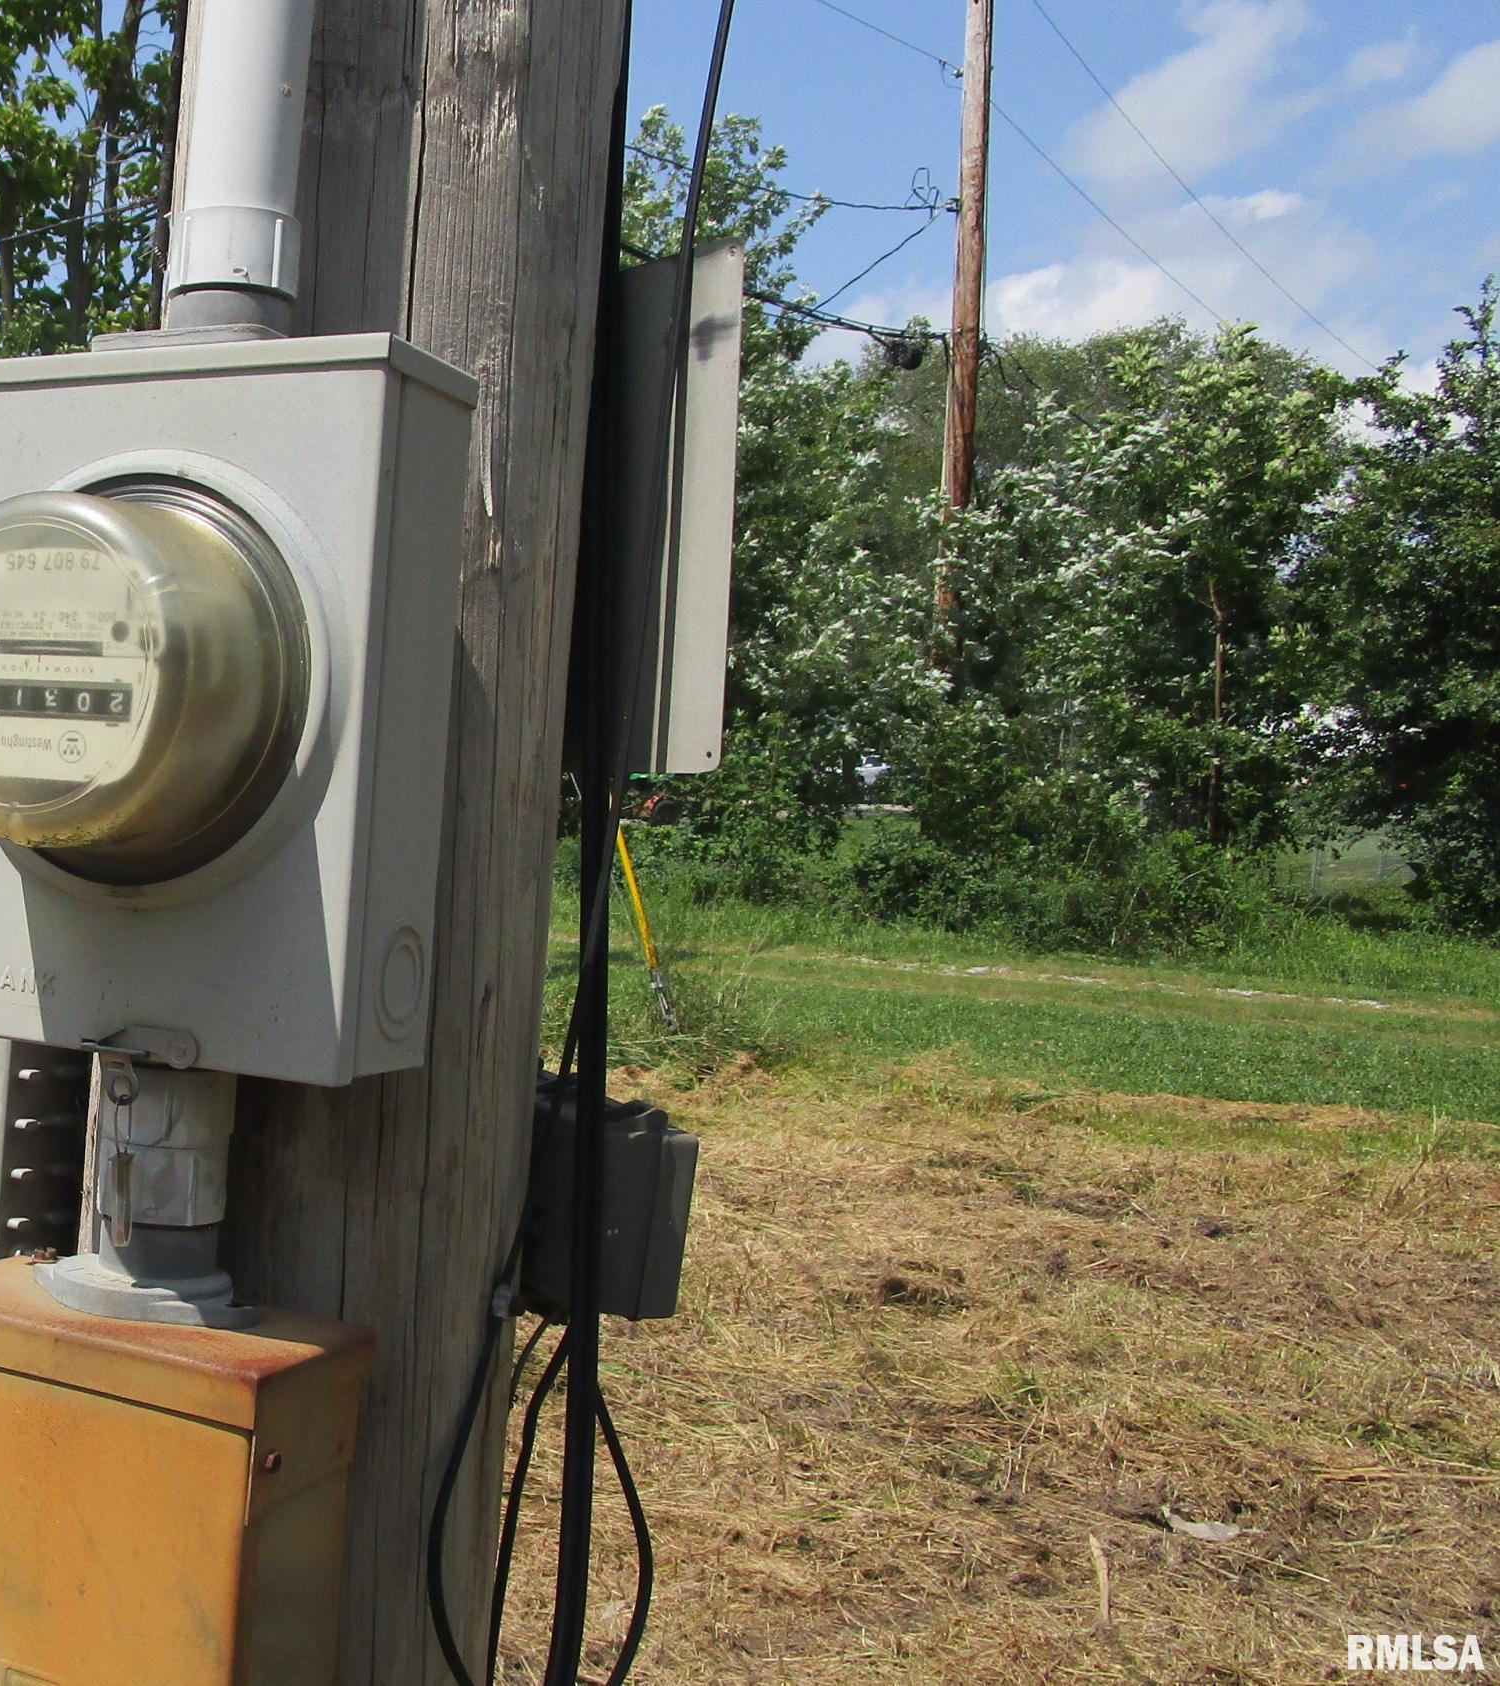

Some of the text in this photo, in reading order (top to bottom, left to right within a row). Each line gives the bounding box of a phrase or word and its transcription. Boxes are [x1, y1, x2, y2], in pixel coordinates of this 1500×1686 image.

[6, 551, 100, 571] 79 807 645
